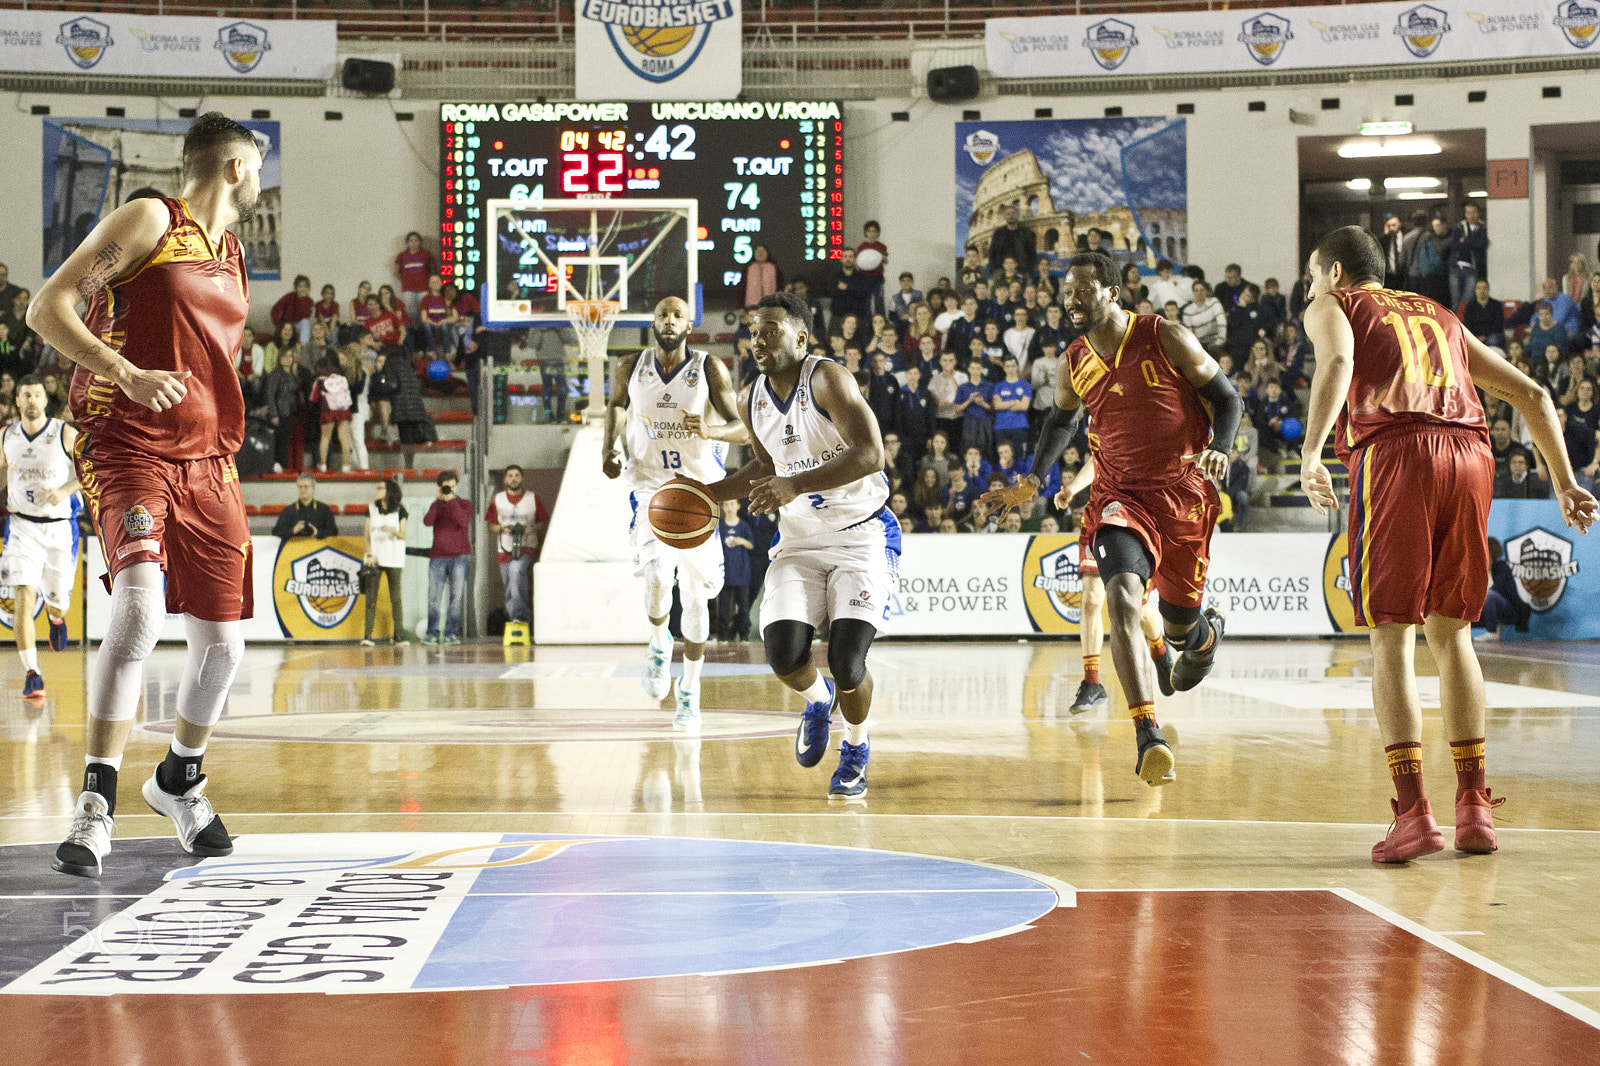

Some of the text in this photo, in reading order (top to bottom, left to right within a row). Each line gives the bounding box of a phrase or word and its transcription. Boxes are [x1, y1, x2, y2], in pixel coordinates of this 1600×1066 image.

[586, 0, 728, 28] EUROBASKET
[642, 59, 675, 73] ROMA
[441, 103, 500, 122] ROMA
[651, 102, 841, 120] UNICUSANO V.ROMA
[445, 122, 454, 135] 0
[817, 120, 825, 133] 1
[834, 120, 843, 133] 0
[446, 136, 454, 149] 2
[454, 136, 464, 149] 2
[560, 130, 626, 151] 04 42
[816, 134, 826, 147] 2
[834, 134, 843, 147] 2
[817, 148, 825, 162] 1
[834, 148, 843, 162] 5
[455, 165, 462, 177] 1
[487, 158, 549, 177] T.OUT
[561, 153, 625, 192] 22
[732, 157, 794, 176] T.OUT
[834, 162, 843, 175] 6
[455, 178, 463, 191] 4
[804, 176, 814, 190] 2
[834, 176, 843, 190] 9
[1496, 170, 1519, 187] F1
[455, 193, 462, 205] 1
[509, 183, 544, 210] 64
[723, 182, 761, 210] 74
[830, 191, 843, 204] 10
[446, 207, 454, 219] 9
[816, 206, 826, 218] 4
[830, 206, 843, 218] 12
[440, 221, 454, 234] 10
[465, 221, 475, 234] 0
[721, 218, 761, 232] PUNTI
[816, 219, 826, 232] 2
[830, 219, 843, 232] 13
[441, 235, 475, 248] 11 2 4
[804, 233, 814, 246] 7
[830, 233, 843, 246] 15
[441, 250, 480, 262] 13 1 12
[519, 238, 540, 265] 2
[733, 235, 753, 264] 5
[804, 248, 842, 260] 2 4 20
[440, 263, 454, 276] 22
[1371, 294, 1437, 316] CHESSA
[1381, 311, 1455, 387] 10
[1140, 359, 1159, 387] 0
[653, 421, 682, 430] ROMA
[656, 431, 664, 439] &
[661, 450, 682, 469] 13
[787, 444, 844, 472] ROMA GAS
[26, 490, 35, 503] 5
[286, 581, 360, 598] EUROBASKE
[898, 576, 1008, 594] ROMA GAS
[1035, 576, 1083, 593] EUROBA
[1204, 576, 1310, 593] ROMA GAS
[905, 595, 1008, 612] & POWER
[1206, 595, 1310, 611] & POWER
[233, 872, 453, 984] ROMA GAS
[40, 897, 284, 985] POWER
